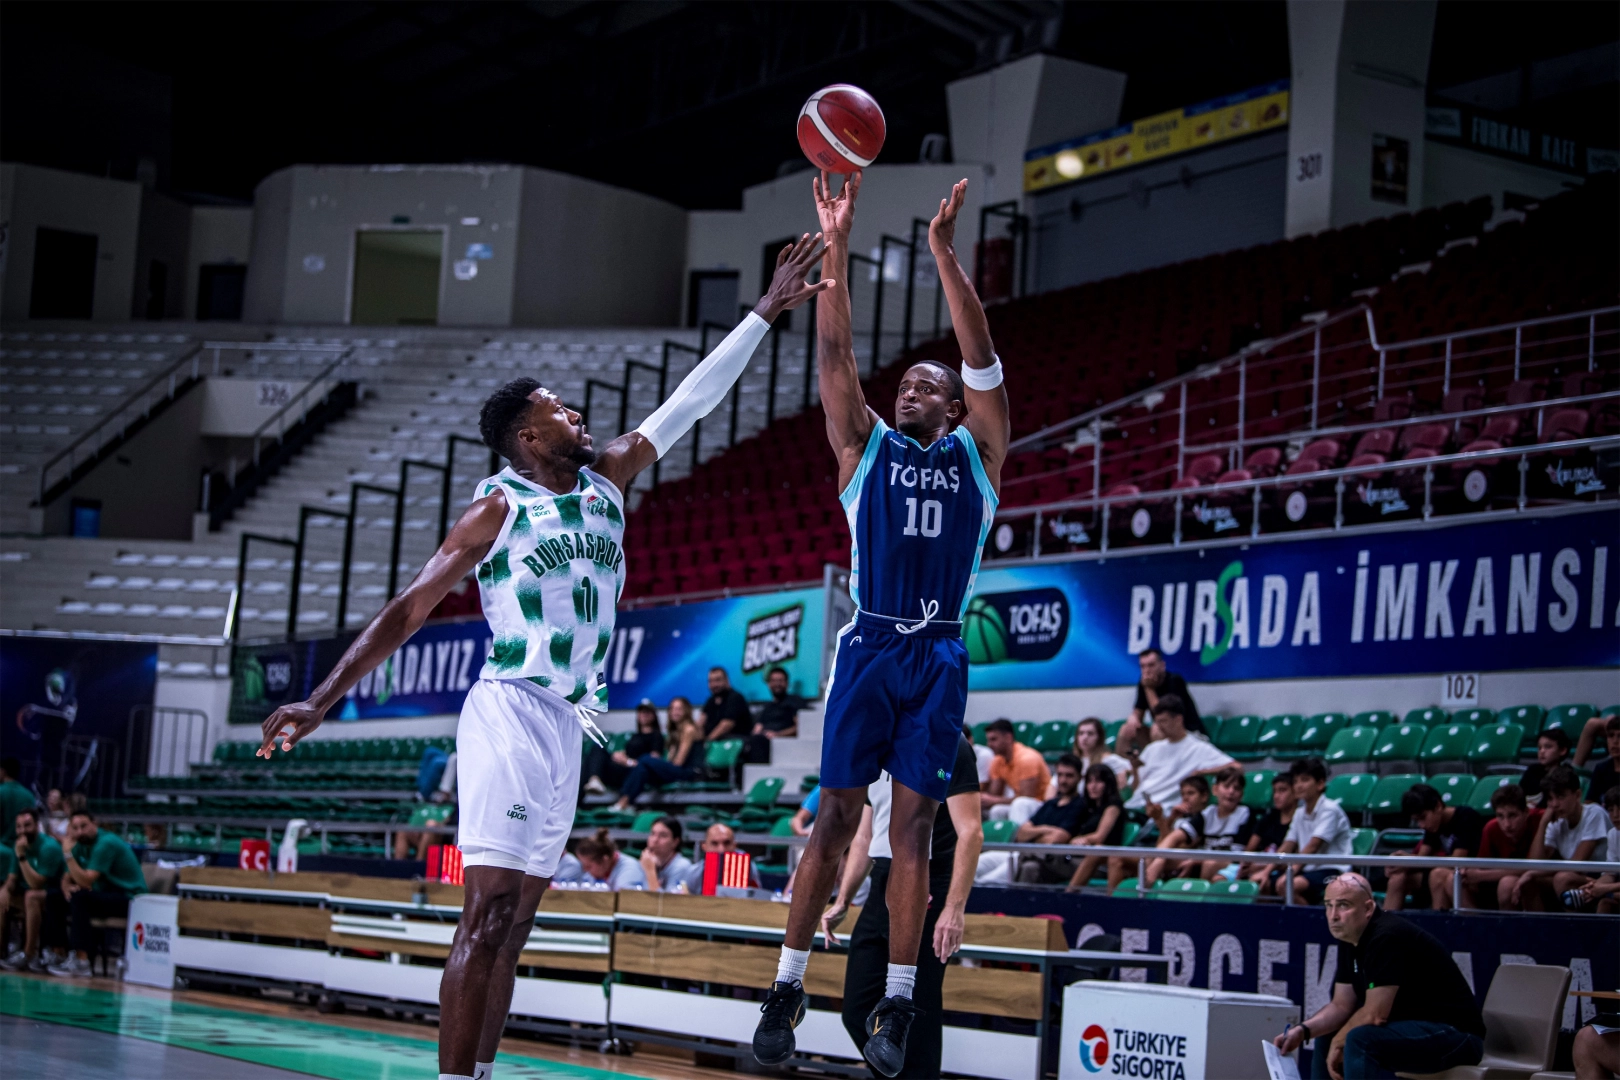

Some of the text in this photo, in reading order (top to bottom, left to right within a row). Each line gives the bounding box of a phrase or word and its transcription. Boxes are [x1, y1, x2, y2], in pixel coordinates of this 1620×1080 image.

[1297, 153, 1322, 181] 301
[890, 461, 960, 493] TOFAŞ
[903, 497, 943, 538] 10
[521, 532, 624, 579] BURSASPOR
[581, 575, 593, 624] 1
[1350, 546, 1620, 643] İMKANSI
[1008, 601, 1062, 639] TOFAŞ
[743, 625, 796, 670] BURSA
[1446, 674, 1476, 699] 102
[506, 809, 528, 822] upon
